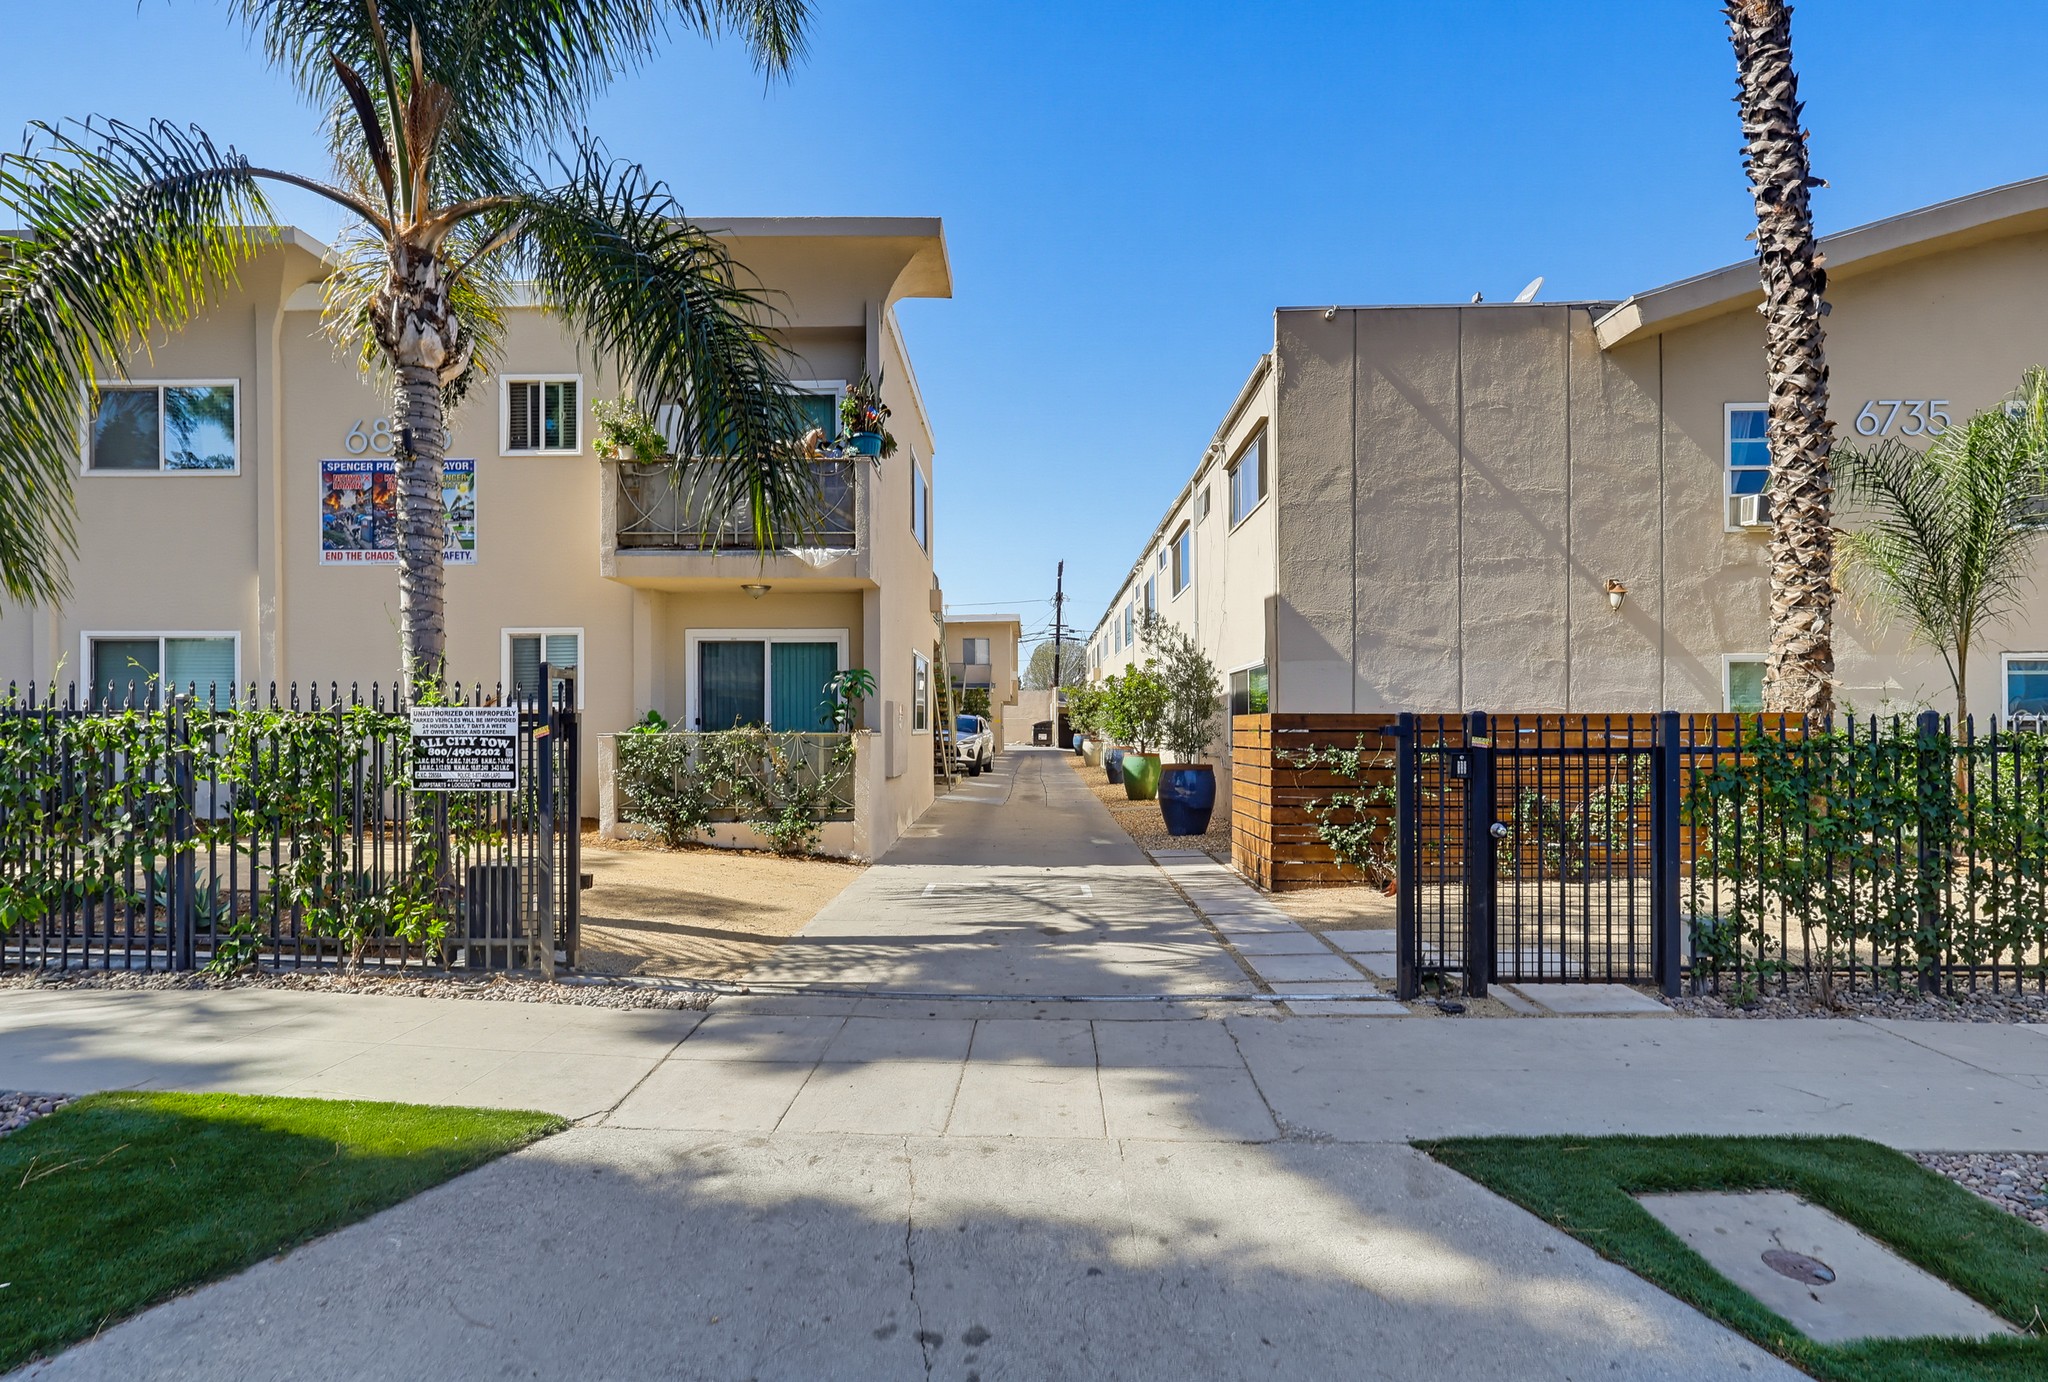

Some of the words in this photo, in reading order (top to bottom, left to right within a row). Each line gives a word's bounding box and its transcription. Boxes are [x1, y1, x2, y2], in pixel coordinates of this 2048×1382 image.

[1855, 400, 1952, 436] 6735
[327, 462, 373, 471] SPENCER
[443, 462, 469, 470] AYOR
[326, 552, 342, 560] END
[346, 552, 362, 560] THE
[365, 552, 397, 560] CHAOS.
[443, 551, 472, 560] AFETY.
[419, 738, 443, 748] ALL
[446, 737, 477, 746] CITY
[480, 737, 510, 749] TOW
[428, 747, 500, 757] 800/498-0202
